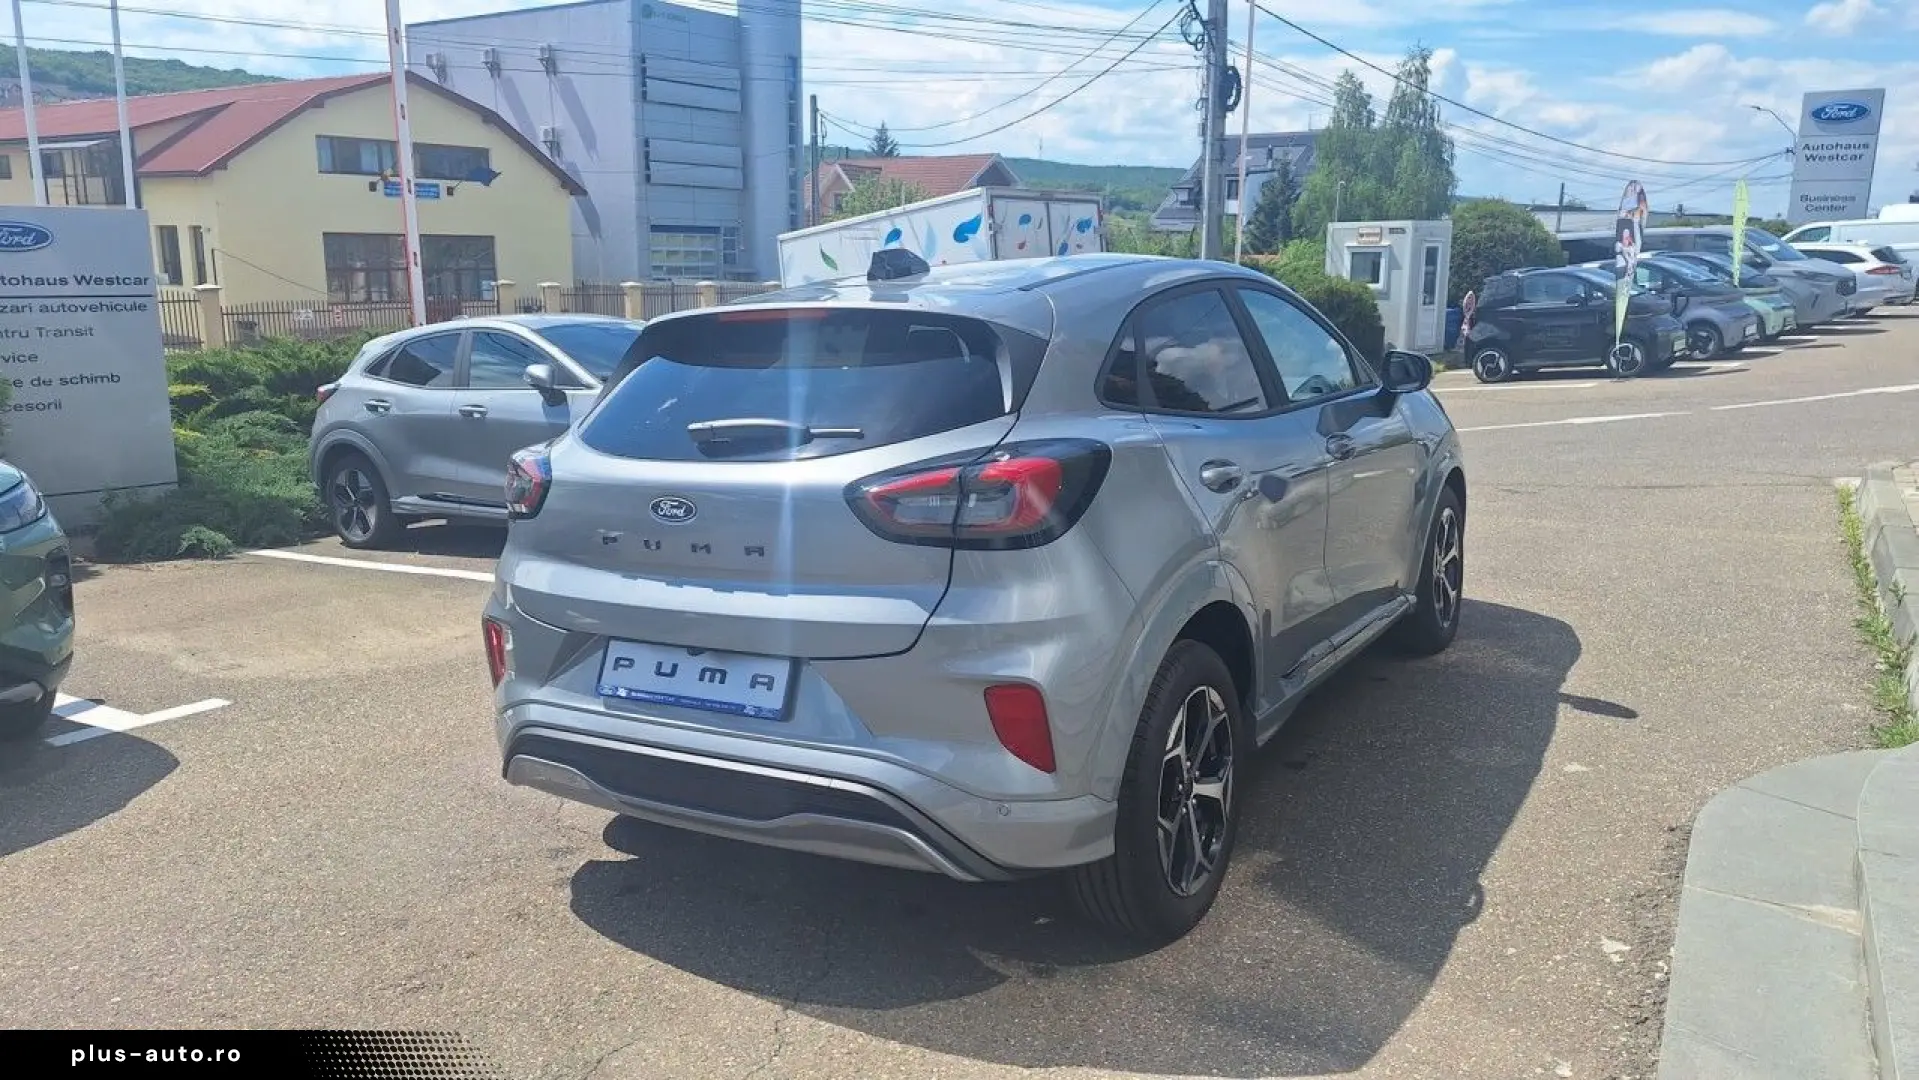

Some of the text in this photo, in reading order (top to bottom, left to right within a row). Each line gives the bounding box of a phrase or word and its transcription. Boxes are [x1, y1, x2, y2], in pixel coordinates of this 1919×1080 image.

[1821, 104, 1857, 119] Ford
[1802, 142, 1869, 151] Autohaus
[1804, 153, 1864, 162] Westcar
[1800, 194, 1857, 202] Business
[1804, 204, 1847, 213] Center
[73, 274, 150, 286] Westcar
[39, 301, 149, 313] autovehicule
[36, 326, 94, 338] Transit
[30, 376, 53, 387] de
[59, 373, 121, 386] schimb
[658, 500, 687, 517] Ford
[602, 536, 765, 557] PUMA
[612, 656, 775, 692] PUMA
